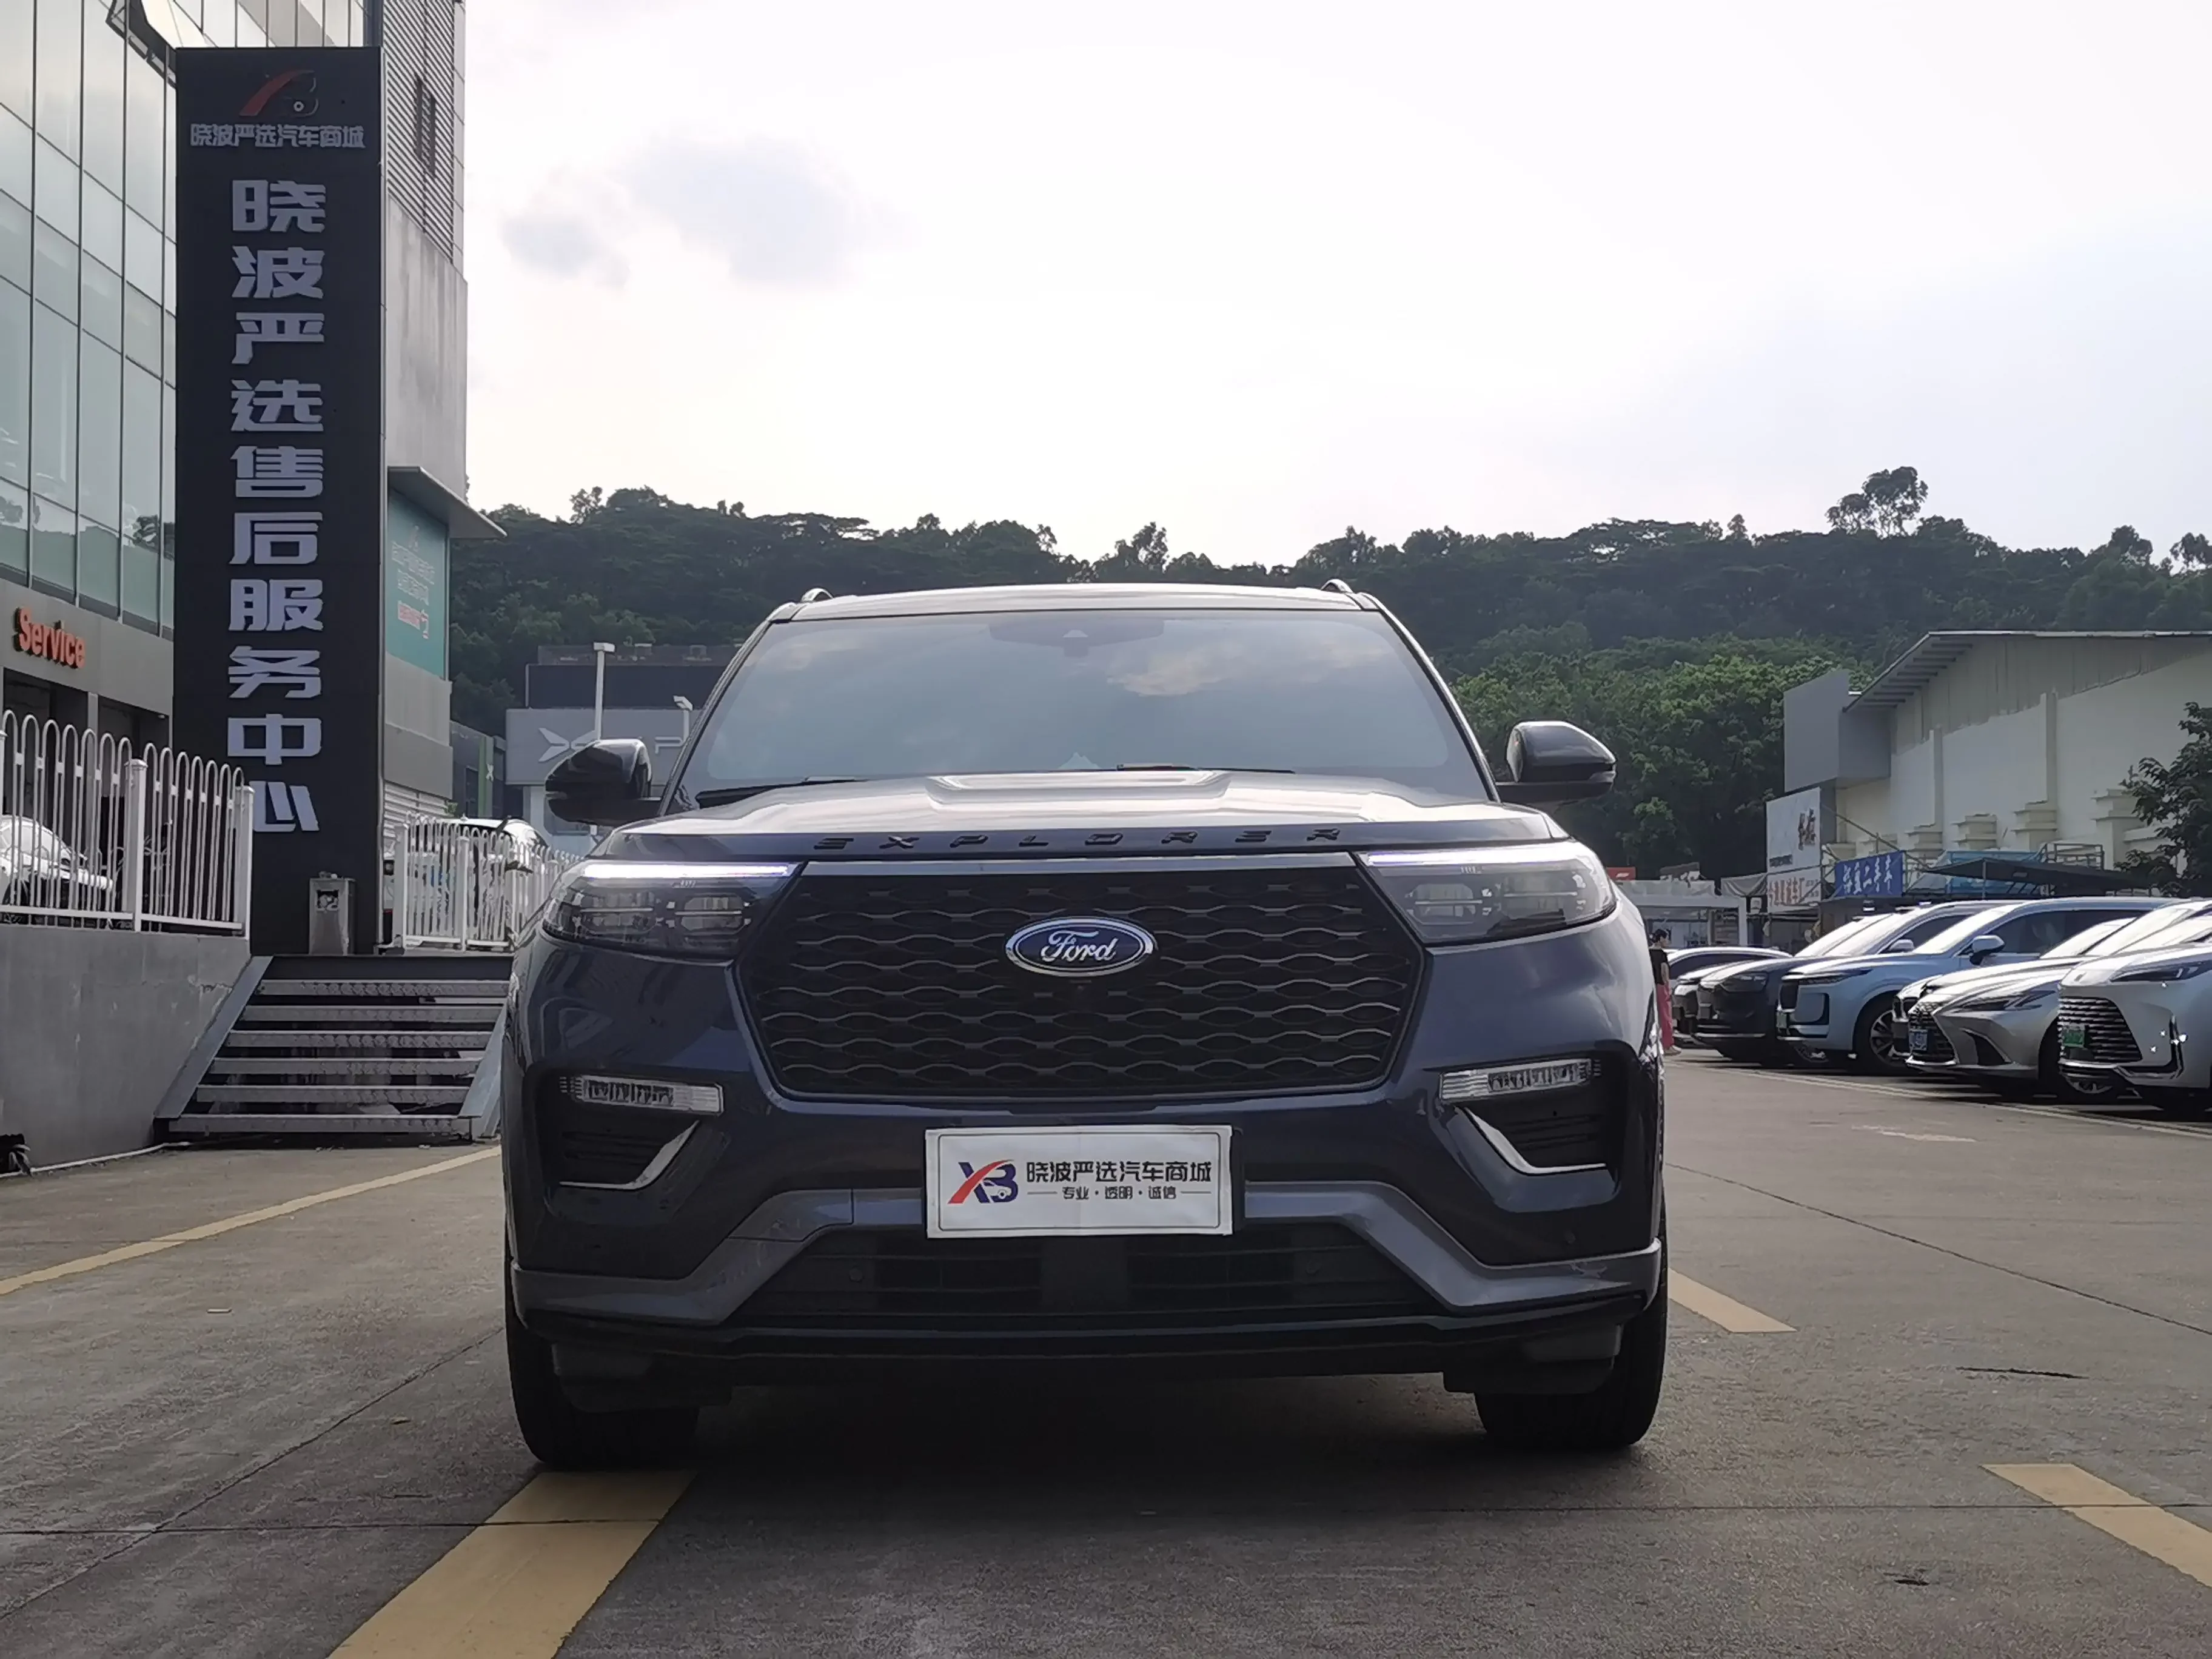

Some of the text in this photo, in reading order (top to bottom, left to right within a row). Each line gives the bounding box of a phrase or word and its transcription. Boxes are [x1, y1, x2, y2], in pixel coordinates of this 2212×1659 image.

[190, 123, 366, 149] 晓波严选汽车商城
[228, 179, 326, 833] 晓波严选售后服务中心
[17, 608, 86, 669] Service
[814, 829, 1342, 850] EXPLORER
[1041, 930, 1117, 962] Ford
[1026, 1161, 1212, 1183] 晓波严选汽车商城
